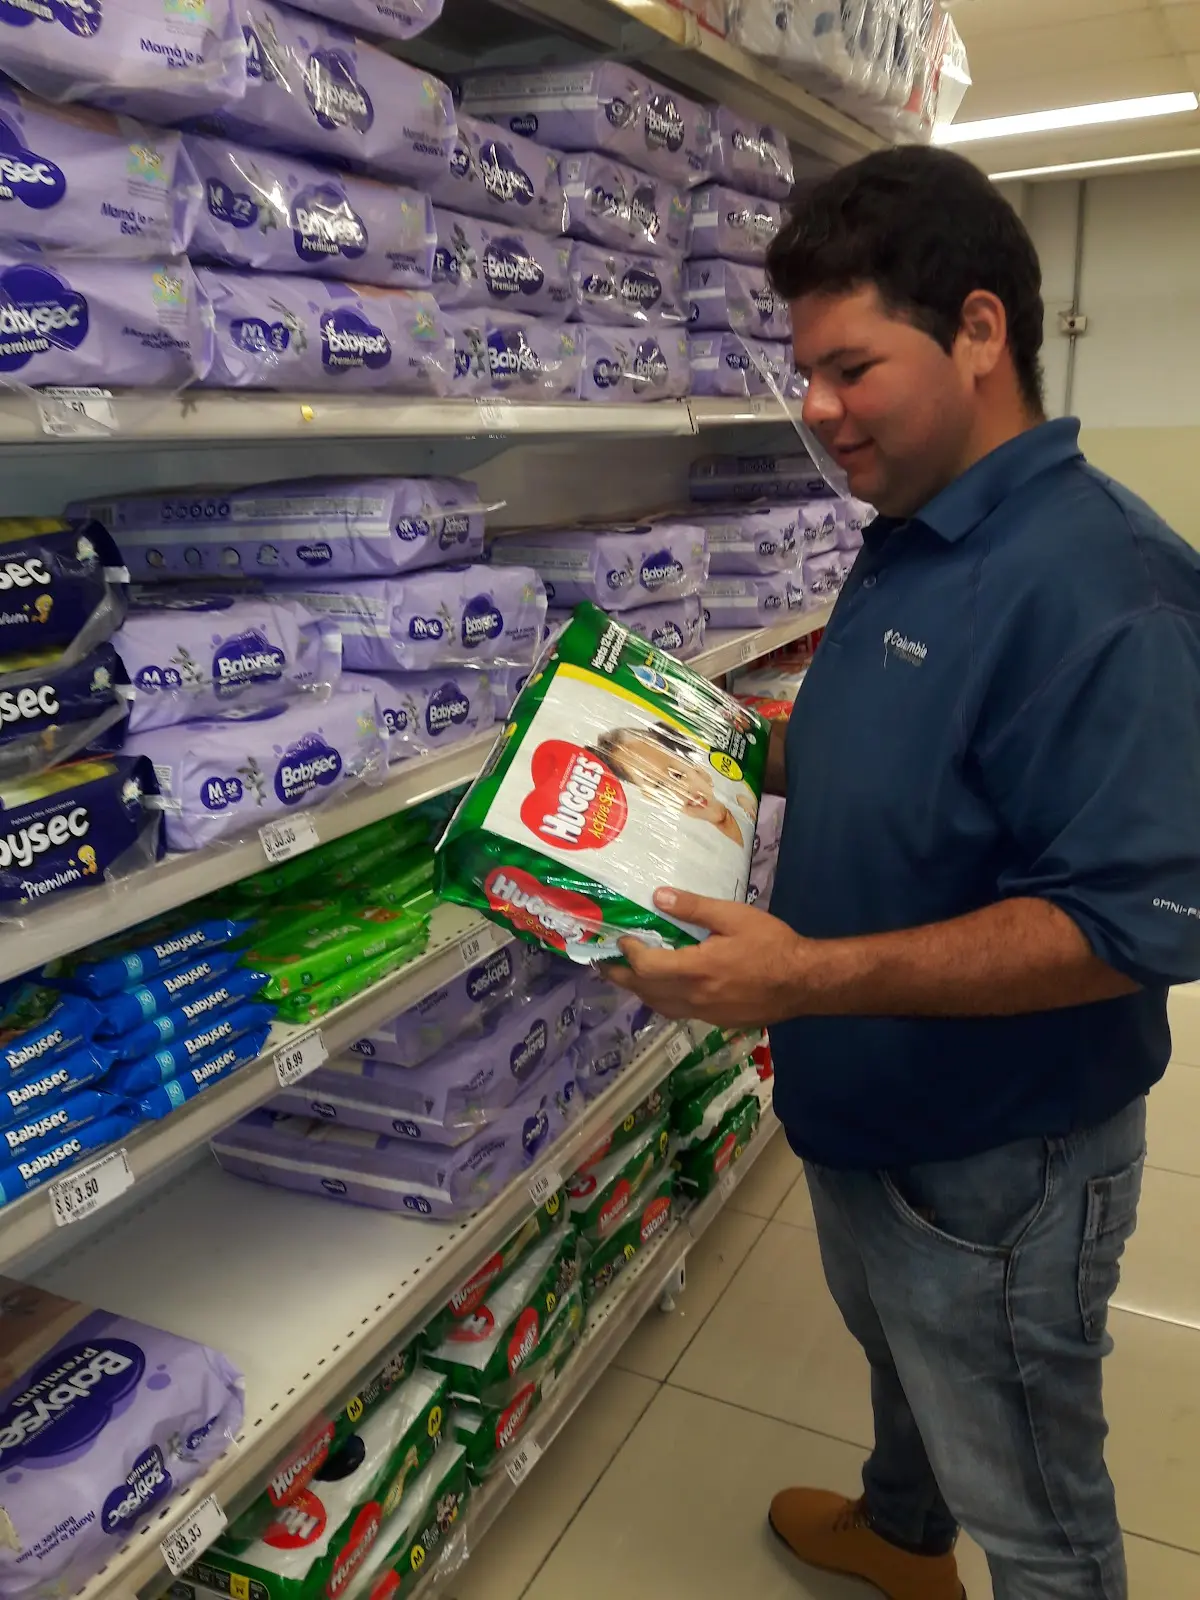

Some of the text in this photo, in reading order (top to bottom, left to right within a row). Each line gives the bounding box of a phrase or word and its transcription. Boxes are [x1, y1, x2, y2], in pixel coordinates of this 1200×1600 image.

[0, 157, 56, 186] sec
[302, 237, 339, 255] Premium
[218, 652, 281, 678] Babysec
[0, 685, 60, 722] sec
[281, 753, 338, 789] Babysec
[539, 755, 605, 844] HUGGIES
[588, 794, 611, 840] Active
[19, 867, 82, 901] Premium
[154, 930, 206, 960] Babysec
[163, 961, 212, 993] Babysec
[181, 987, 230, 1019] Babysec
[5, 1028, 64, 1070] Babysec
[184, 1021, 233, 1054] Babysec
[191, 1049, 237, 1084] Babysec
[287, 1050, 304, 1070] 6.99
[7, 1067, 70, 1107] Babysec
[4, 1109, 69, 1148] Babysec
[18, 1137, 82, 1181] Babysec
[76, 1177, 99, 1200] 3.50
[11, 1346, 99, 1407] Premium
[109, 1460, 166, 1529] Babysec
[73, 1510, 97, 1533] Mamá
